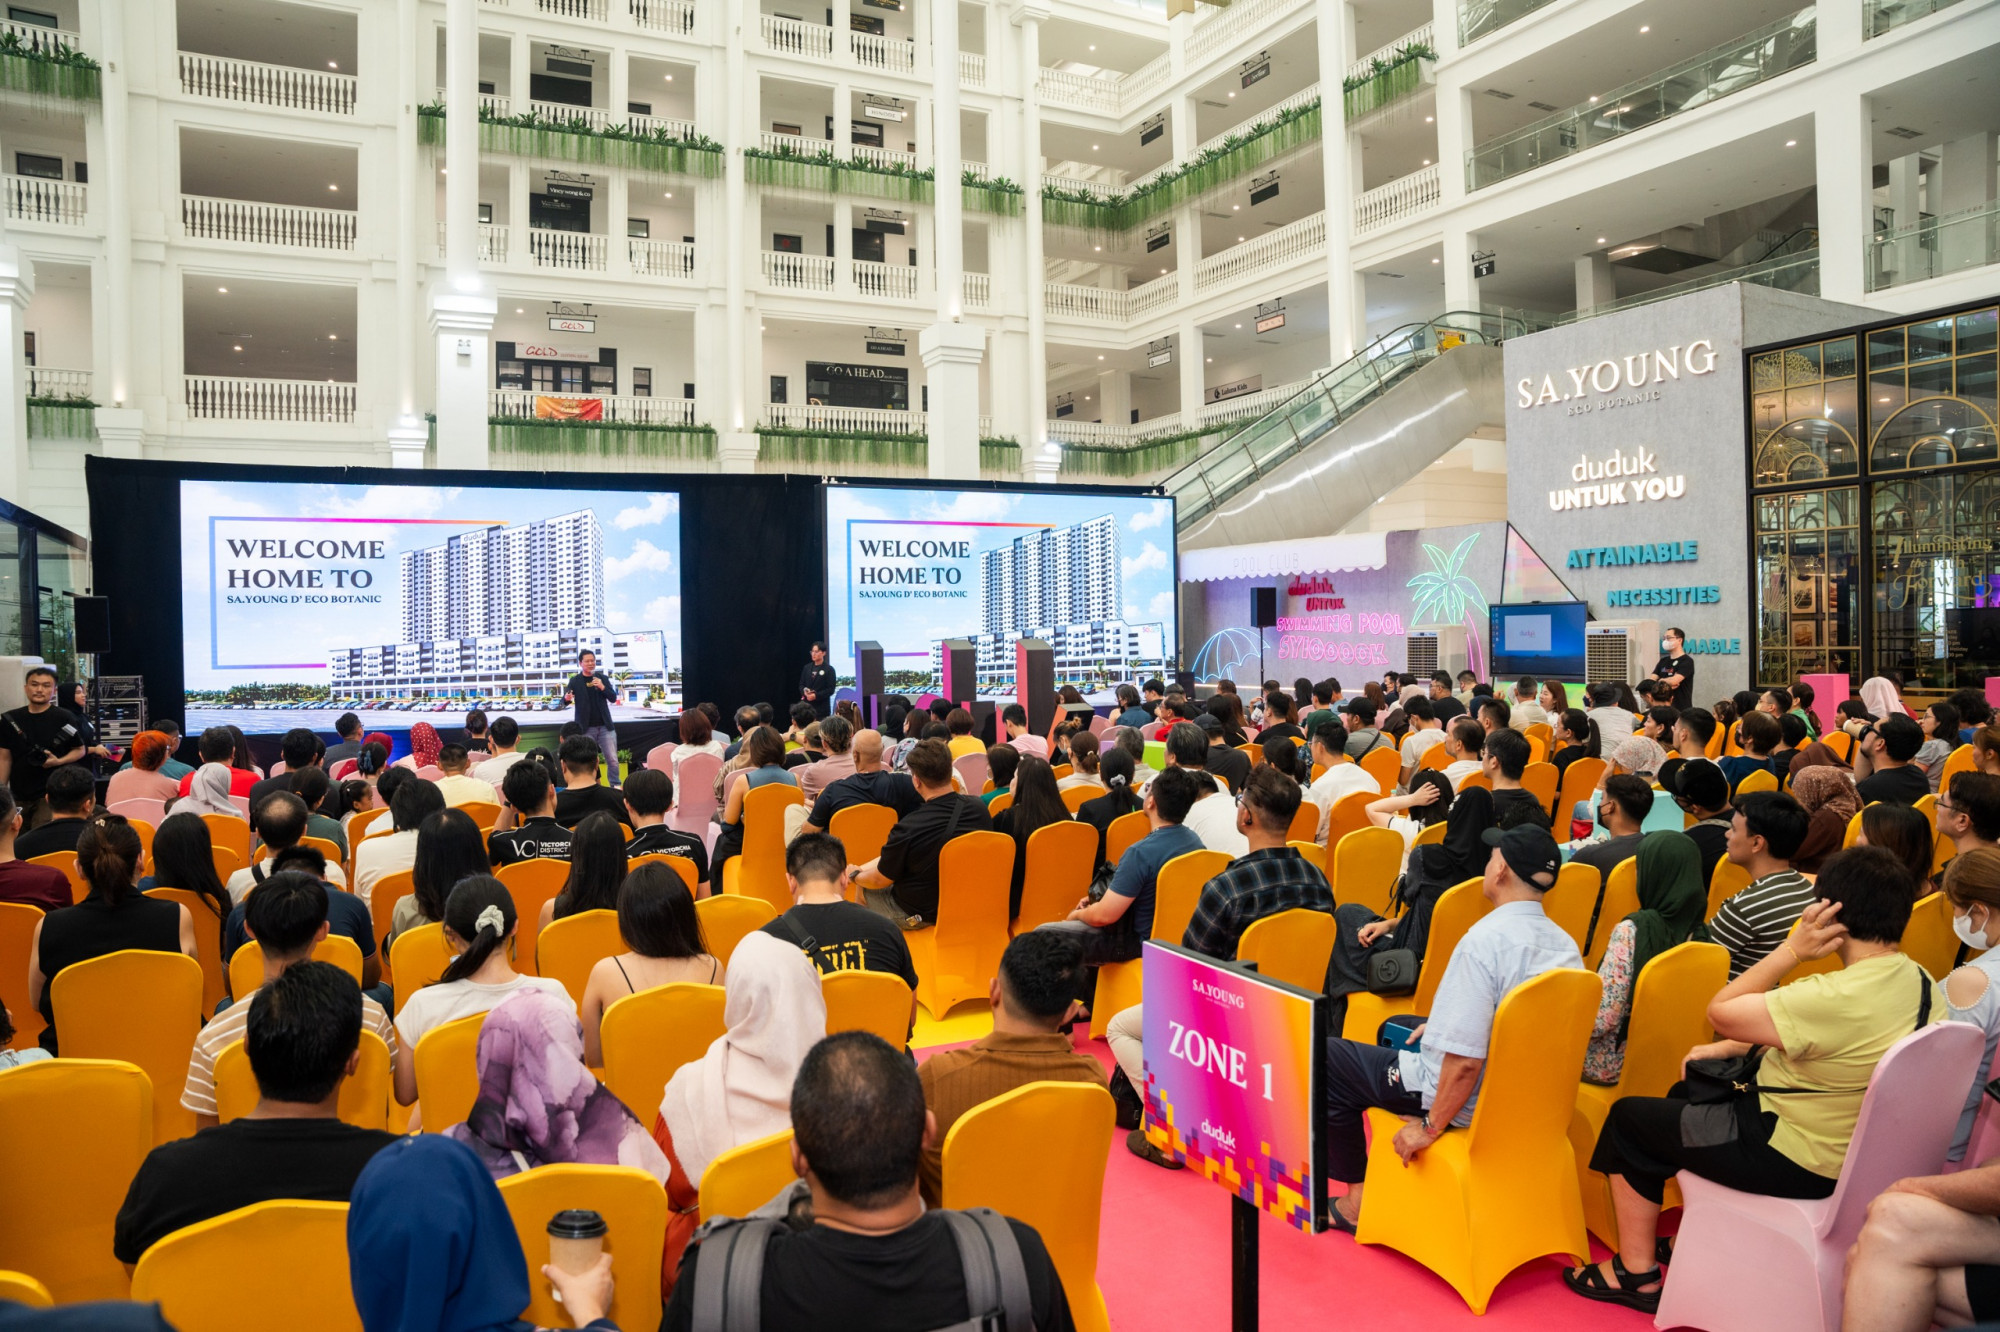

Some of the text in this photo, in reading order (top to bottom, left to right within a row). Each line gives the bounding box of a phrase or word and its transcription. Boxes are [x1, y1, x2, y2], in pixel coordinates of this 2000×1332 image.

[526, 346, 558, 357] GOLD
[826, 366, 842, 376] GO
[845, 367, 853, 377] A
[854, 368, 885, 379] HEAD
[1517, 339, 1718, 408] SA.YOUNG
[1567, 391, 1661, 416] ECO BOTANIC
[1572, 445, 1658, 482] duduk
[1549, 475, 1687, 511] UNTUK YOU
[226, 539, 385, 559] WELCOME
[859, 539, 970, 558] WELCOME
[1566, 540, 1699, 569] ATTAINABLE
[1891, 535, 1992, 565] Illuminating
[1234, 552, 1300, 573] POOL CLUB
[227, 569, 373, 589] HOME TO
[860, 566, 962, 585] HOME TO
[1288, 575, 1336, 596] duduk
[227, 595, 288, 604] SA.YOUNG
[304, 595, 329, 604] ECO
[331, 595, 382, 604] BOTANIC
[859, 590, 902, 598] SA.YOUNG
[914, 590, 931, 598] ECO
[932, 590, 968, 598] BOTANIC
[1607, 585, 1722, 607] NECESSITIES
[1888, 570, 1992, 609] Forward
[1306, 597, 1346, 612] UNTUK
[1276, 612, 1405, 636] SWIMMING POOL
[511, 839, 536, 858] VC
[1192, 978, 1245, 1009] SA.YOUNG
[1168, 1020, 1274, 1101] ZONE 1
[1201, 1118, 1236, 1149] duduk
